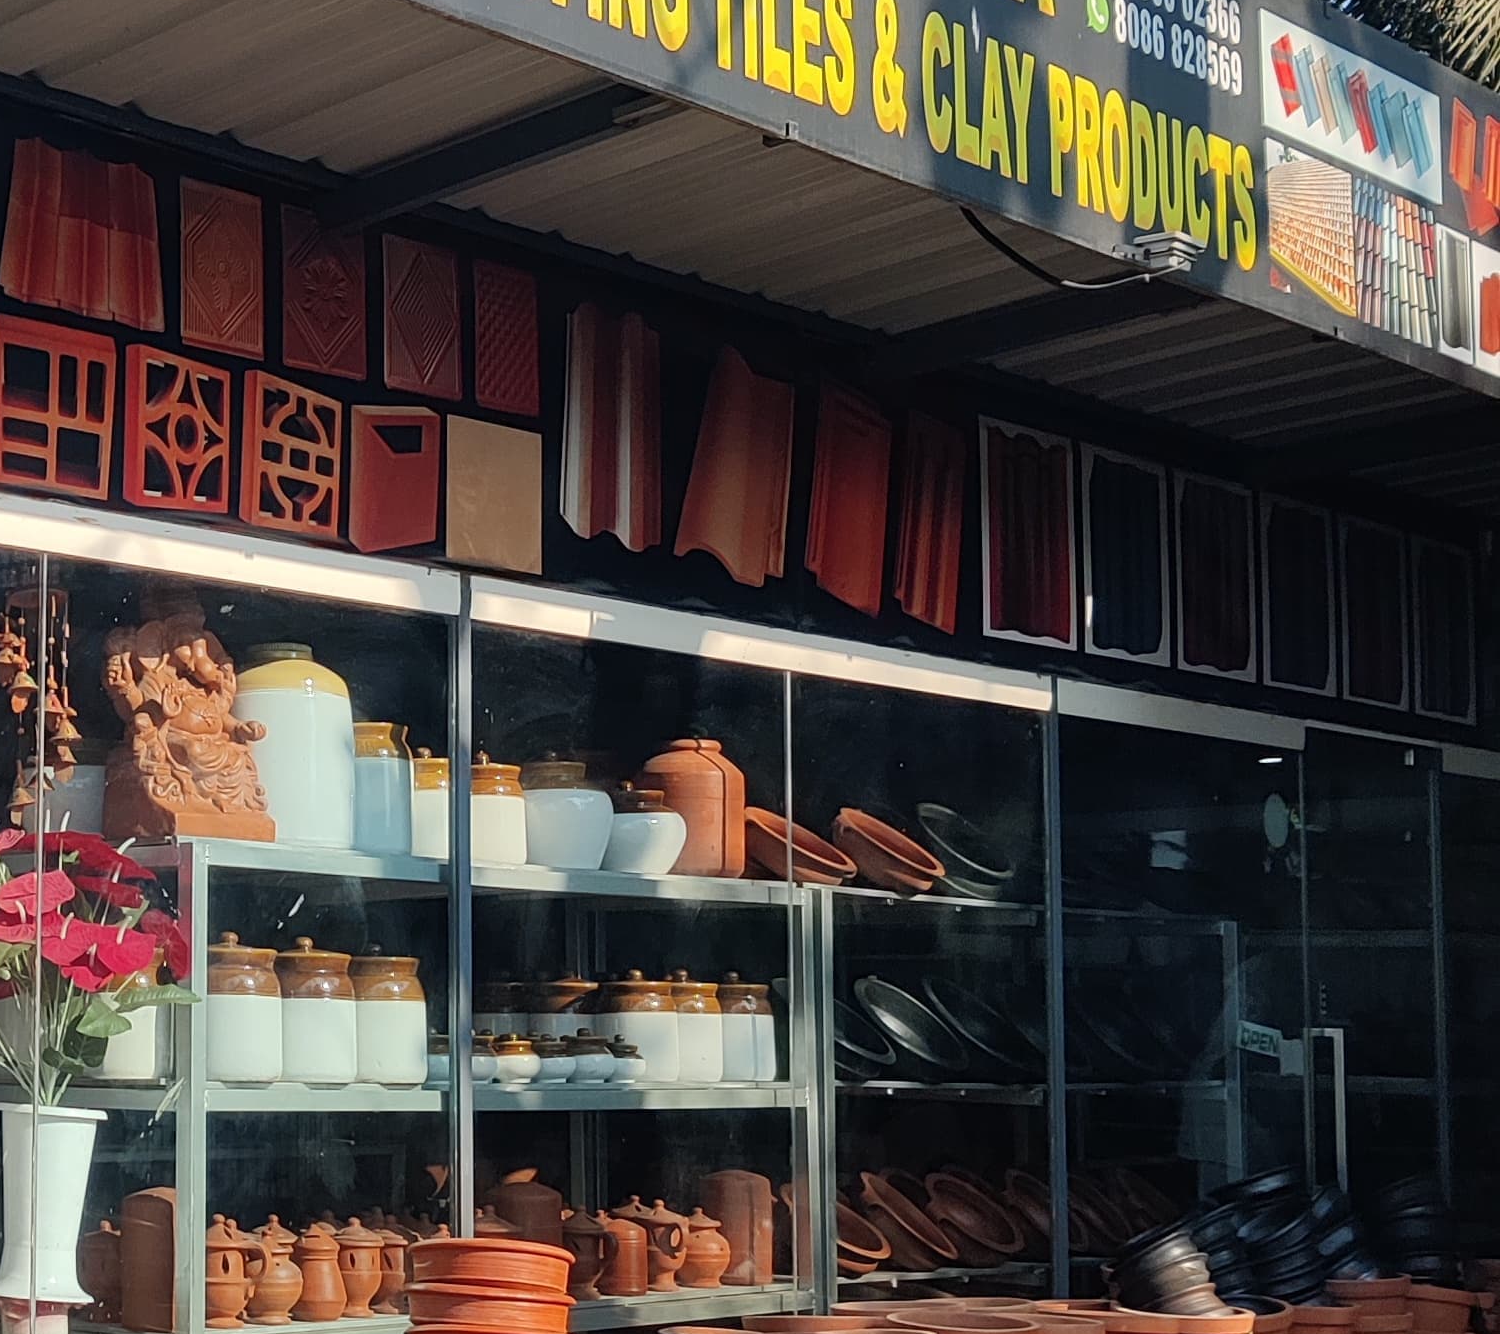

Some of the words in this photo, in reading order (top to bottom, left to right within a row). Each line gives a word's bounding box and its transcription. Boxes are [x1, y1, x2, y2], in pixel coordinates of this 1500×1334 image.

[1171, 23, 1243, 97] 828569
[921, 10, 1036, 186] CLAY
[1047, 62, 1257, 272] PRODUCTS
[1240, 1026, 1280, 1054] OPEN
